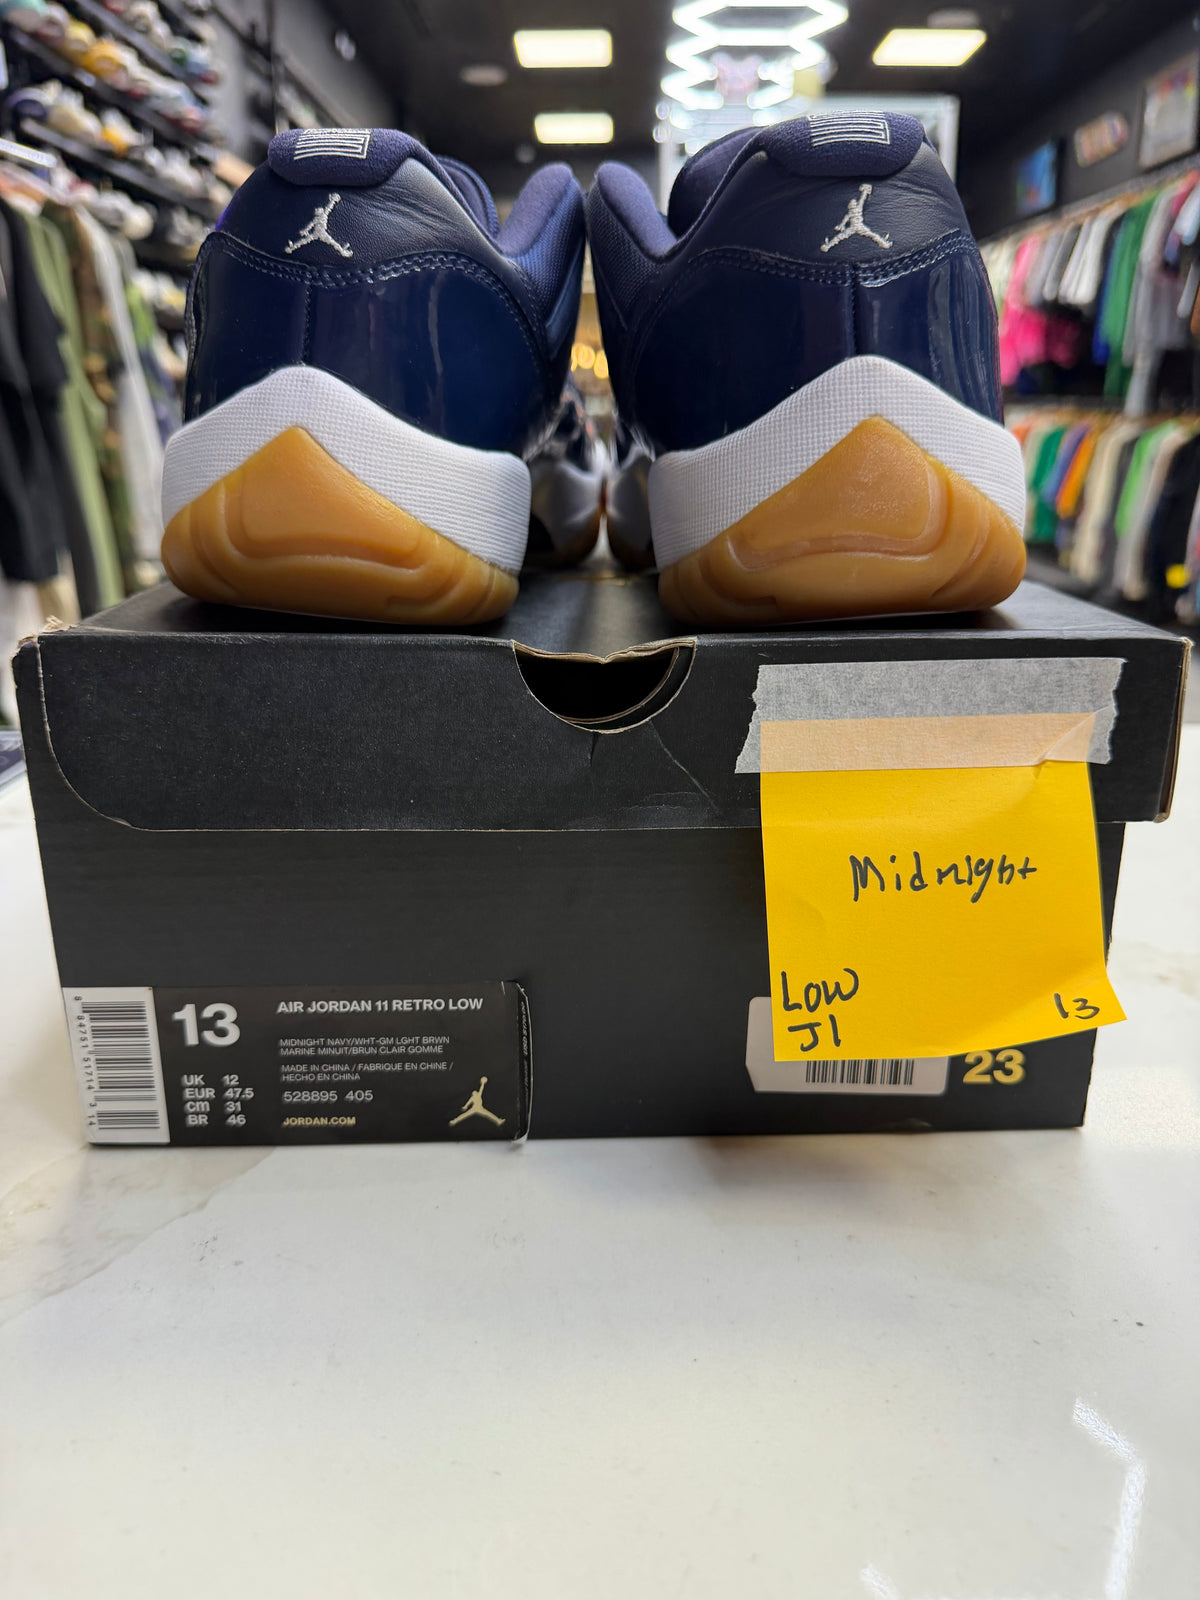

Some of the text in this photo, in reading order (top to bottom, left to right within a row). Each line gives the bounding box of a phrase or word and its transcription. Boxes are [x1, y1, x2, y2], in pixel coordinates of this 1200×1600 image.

[849, 851, 1037, 904] Midnight
[277, 998, 484, 1013] AIR JORDAN 11 RETRO LOW
[1053, 993, 1100, 1020] 13
[172, 1002, 241, 1047] 13
[280, 1036, 450, 1047] MIDNIGHT NAVY/WHT-GM LGHT BRWN
[280, 1045, 445, 1056] MARINE MINUIT/BRUN CLAIR GOMME
[281, 1064, 308, 1072] MADE
[310, 1064, 320, 1072] IN
[321, 1063, 350, 1072] CHINA
[358, 1062, 403, 1071] FABRIQUE
[405, 1062, 417, 1071] EN
[419, 1062, 448, 1070] CHINE
[963, 1048, 1026, 1086] 23
[82, 1057, 96, 1091] 51714
[182, 1074, 240, 1086] UK 12
[282, 1072, 361, 1082] HECHO EN CHINA
[184, 1087, 255, 1099] EUR 47.5
[282, 1089, 374, 1102] 528895 405
[225, 1101, 242, 1112] 31
[187, 1114, 247, 1127] BR 46
[282, 1116, 356, 1127] JORDAN.COM
